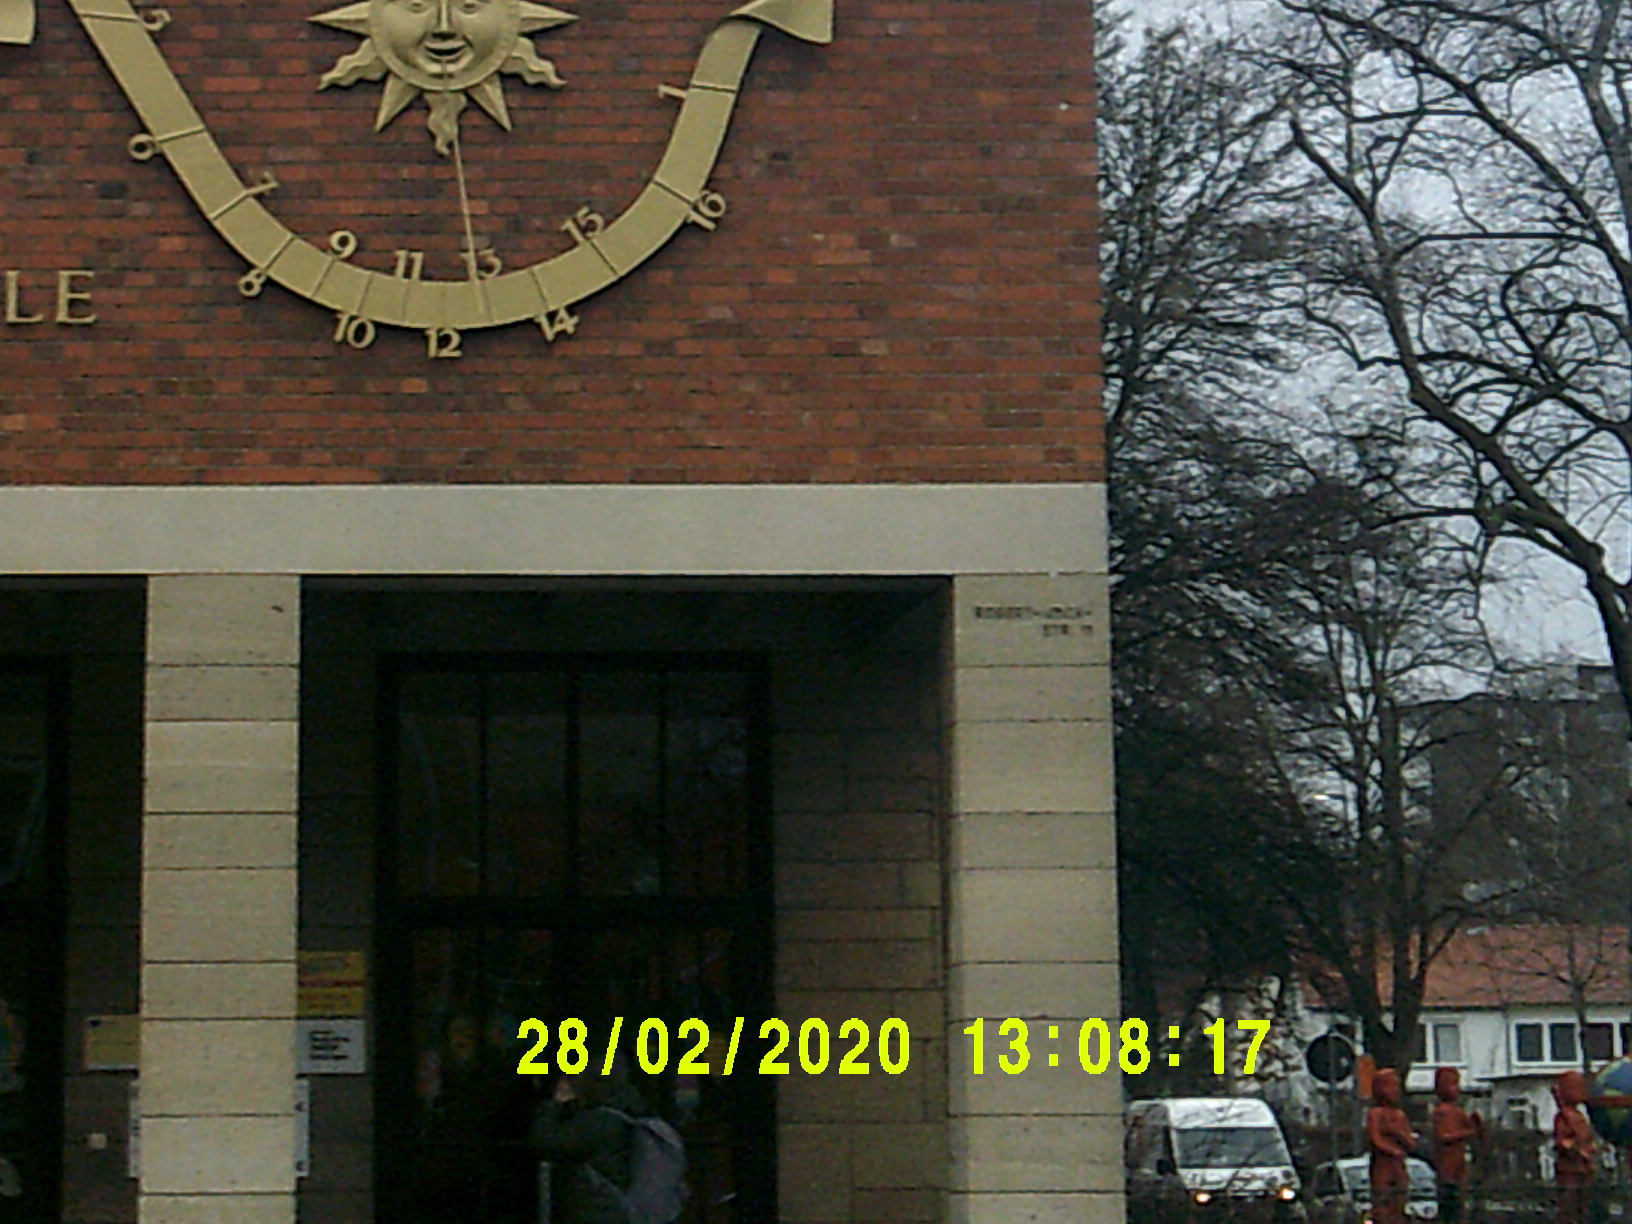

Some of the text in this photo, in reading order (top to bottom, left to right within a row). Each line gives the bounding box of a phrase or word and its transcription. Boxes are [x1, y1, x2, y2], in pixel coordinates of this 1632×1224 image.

[560, 206, 605, 242] 15
[685, 189, 727, 231] 16
[329, 229, 358, 259] 9
[394, 249, 424, 281] 11
[459, 248, 503, 279] 13
[334, 313, 376, 349] 10
[534, 306, 580, 342] 14
[424, 327, 463, 359] 12
